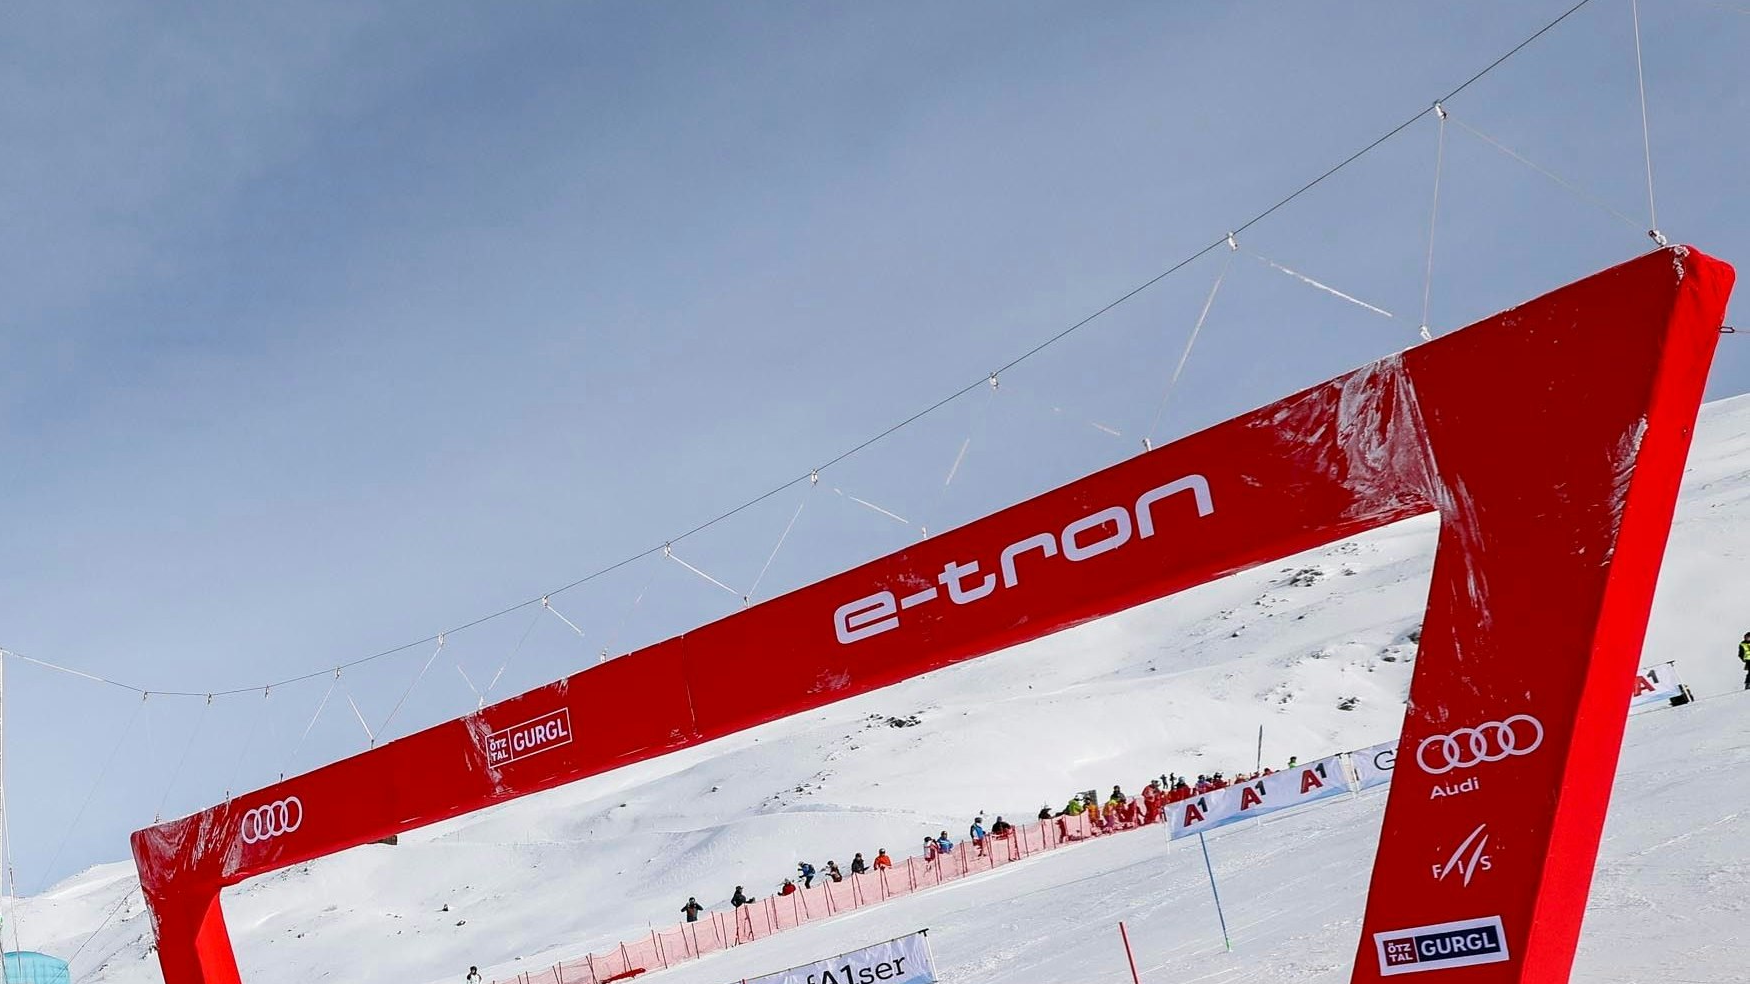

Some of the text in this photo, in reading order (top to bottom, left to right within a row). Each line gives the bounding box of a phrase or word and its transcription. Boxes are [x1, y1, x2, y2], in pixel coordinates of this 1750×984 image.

[833, 473, 1214, 645] e-tron
[1633, 669, 1659, 697] A1
[490, 738, 507, 751] ÖTZ
[513, 718, 568, 752] GURGL
[490, 750, 508, 762] TAL
[1300, 763, 1327, 794] A1
[1430, 776, 1480, 800] Audi
[1240, 780, 1267, 811] A1
[1183, 797, 1208, 827] A1
[1387, 941, 1411, 954] ÖTZ
[1420, 931, 1496, 957] GURGL
[1389, 953, 1414, 963] TAL
